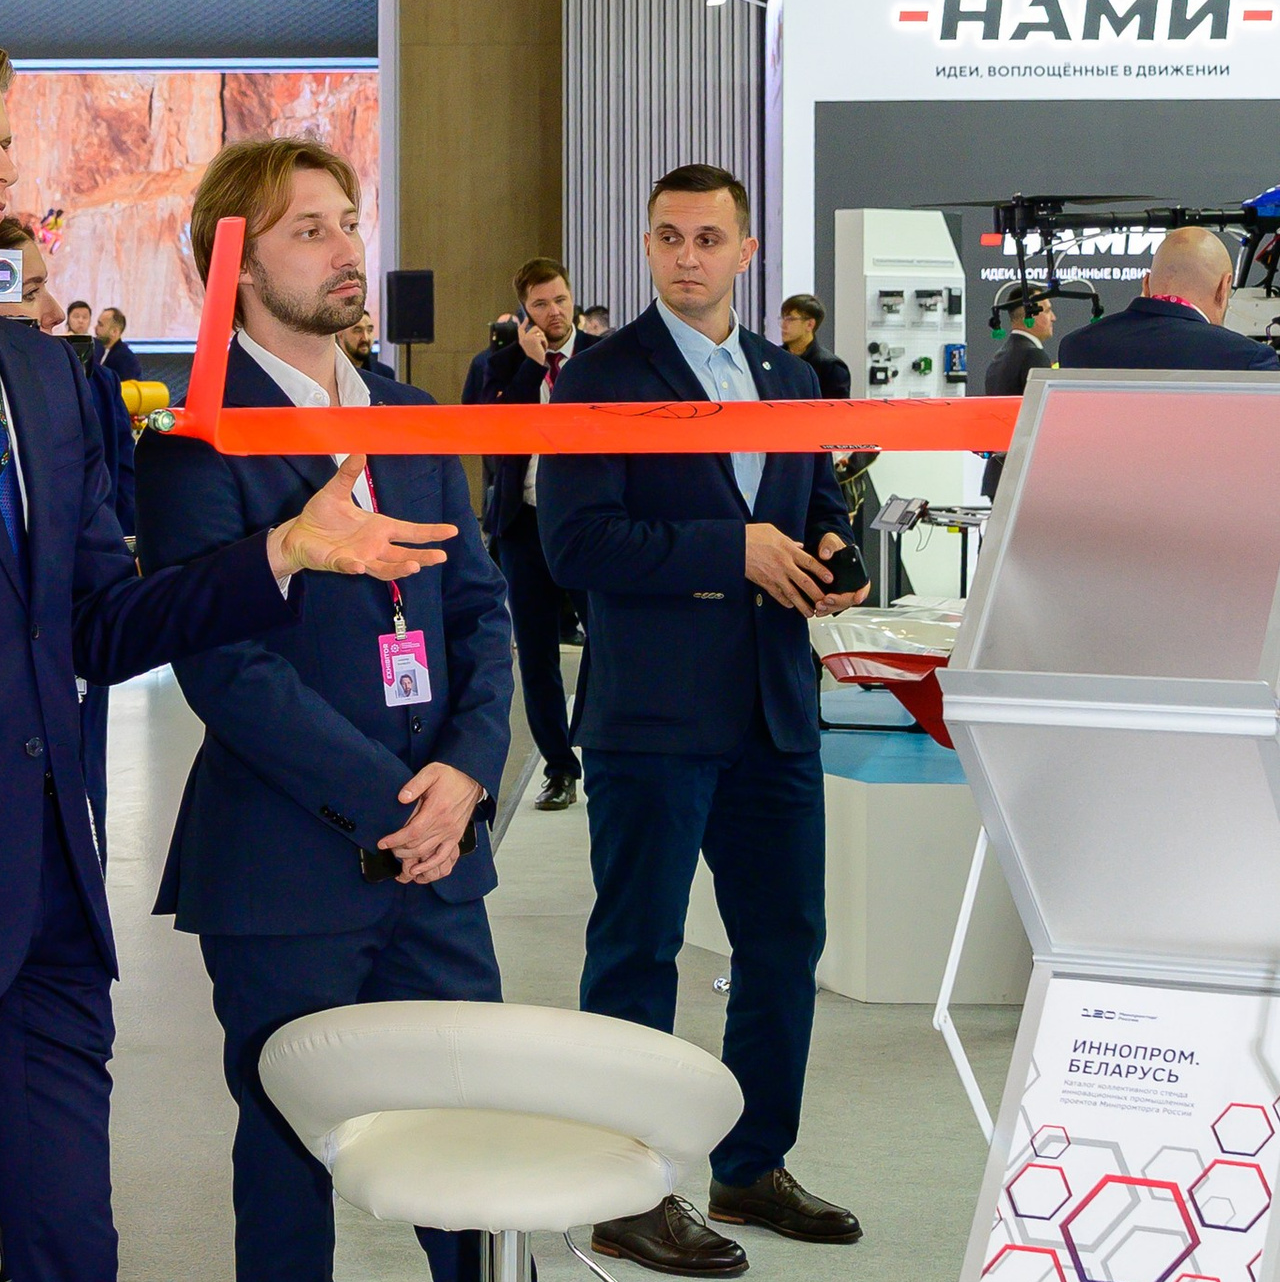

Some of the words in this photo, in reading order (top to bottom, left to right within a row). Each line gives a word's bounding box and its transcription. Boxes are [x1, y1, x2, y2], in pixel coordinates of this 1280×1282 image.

[935, 65, 983, 79] ИДЕИ,
[988, 62, 1119, 78] ВОПЛОЩЁННЫЕ
[1123, 65, 1132, 77] В
[1135, 64, 1230, 78] ДВИЖЕНИИ
[1072, 1039, 1200, 1066] ИННОПРОМ.
[1068, 1058, 1179, 1084] БЕЛАРУСЬ
[1064, 1079, 1095, 1089] Каталог
[1160, 1091, 1188, 1099] стенда
[1060, 1098, 1097, 1107] проектов
[1162, 1108, 1192, 1117] России
